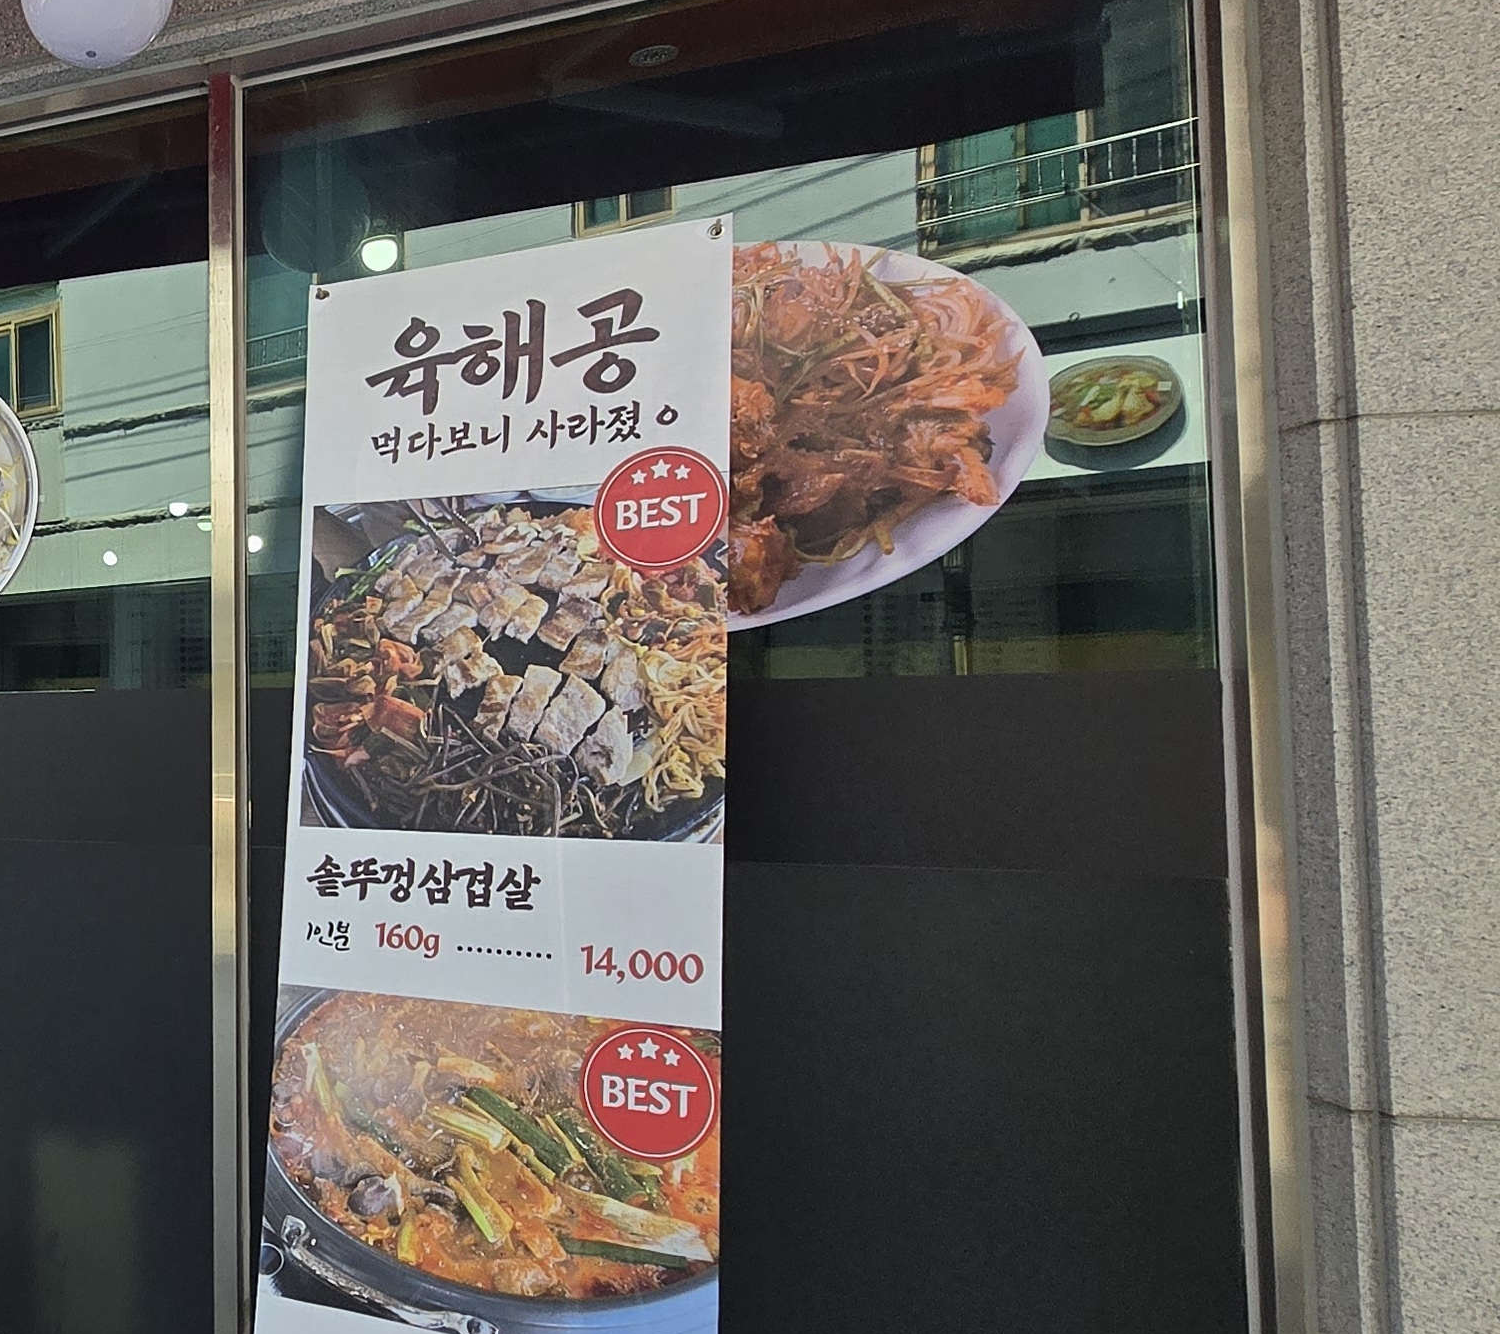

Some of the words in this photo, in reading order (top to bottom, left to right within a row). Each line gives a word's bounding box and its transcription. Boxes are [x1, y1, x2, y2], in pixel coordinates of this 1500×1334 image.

[365, 288, 660, 415] 육해공
[371, 414, 511, 464] 먹다보니
[615, 492, 708, 531] BEST
[306, 853, 541, 911] 솥뚜껑삼겹살
[375, 922, 441, 959] 160g
[581, 945, 705, 985] 14,000
[601, 1074, 698, 1119] BEST
